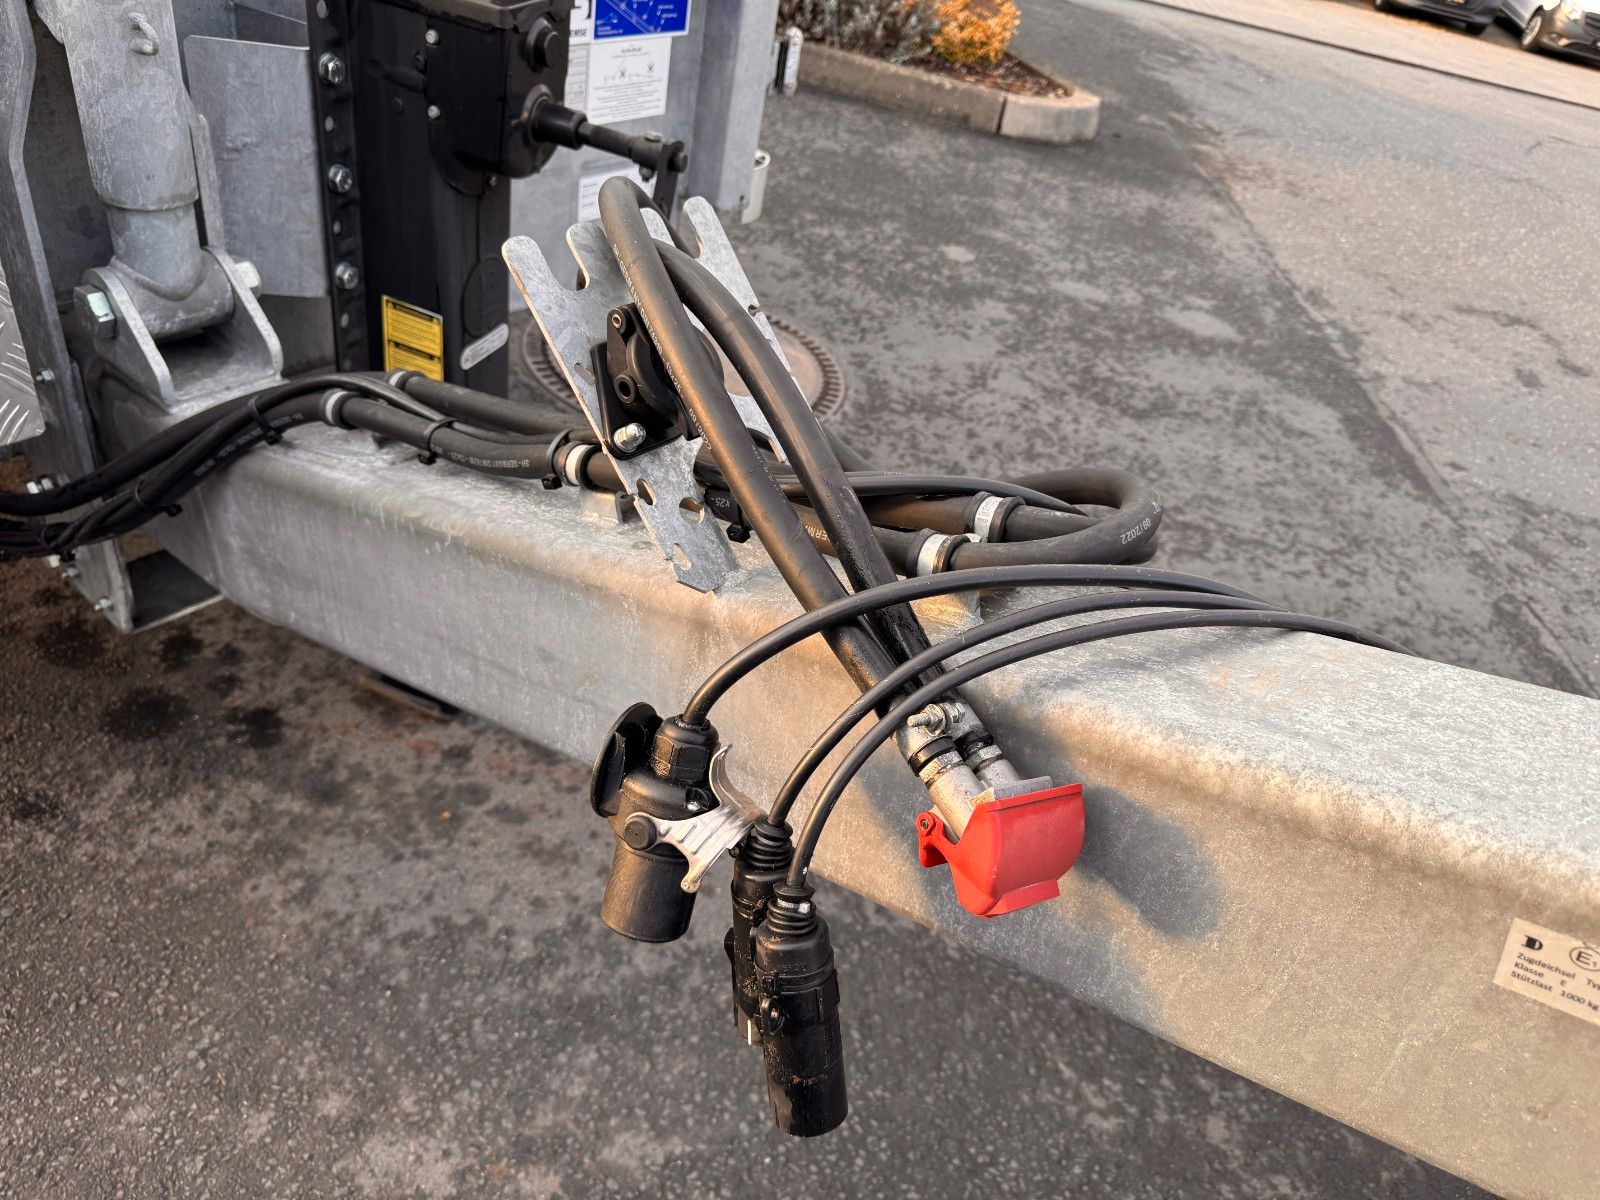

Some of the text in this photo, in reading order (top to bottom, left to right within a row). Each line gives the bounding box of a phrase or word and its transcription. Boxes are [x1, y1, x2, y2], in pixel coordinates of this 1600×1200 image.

[1514, 961, 1545, 978] Klasse
[1516, 951, 1577, 980] Zugdeichsel
[1510, 970, 1553, 993] Stützlast
[1560, 990, 1586, 1005] 1000
